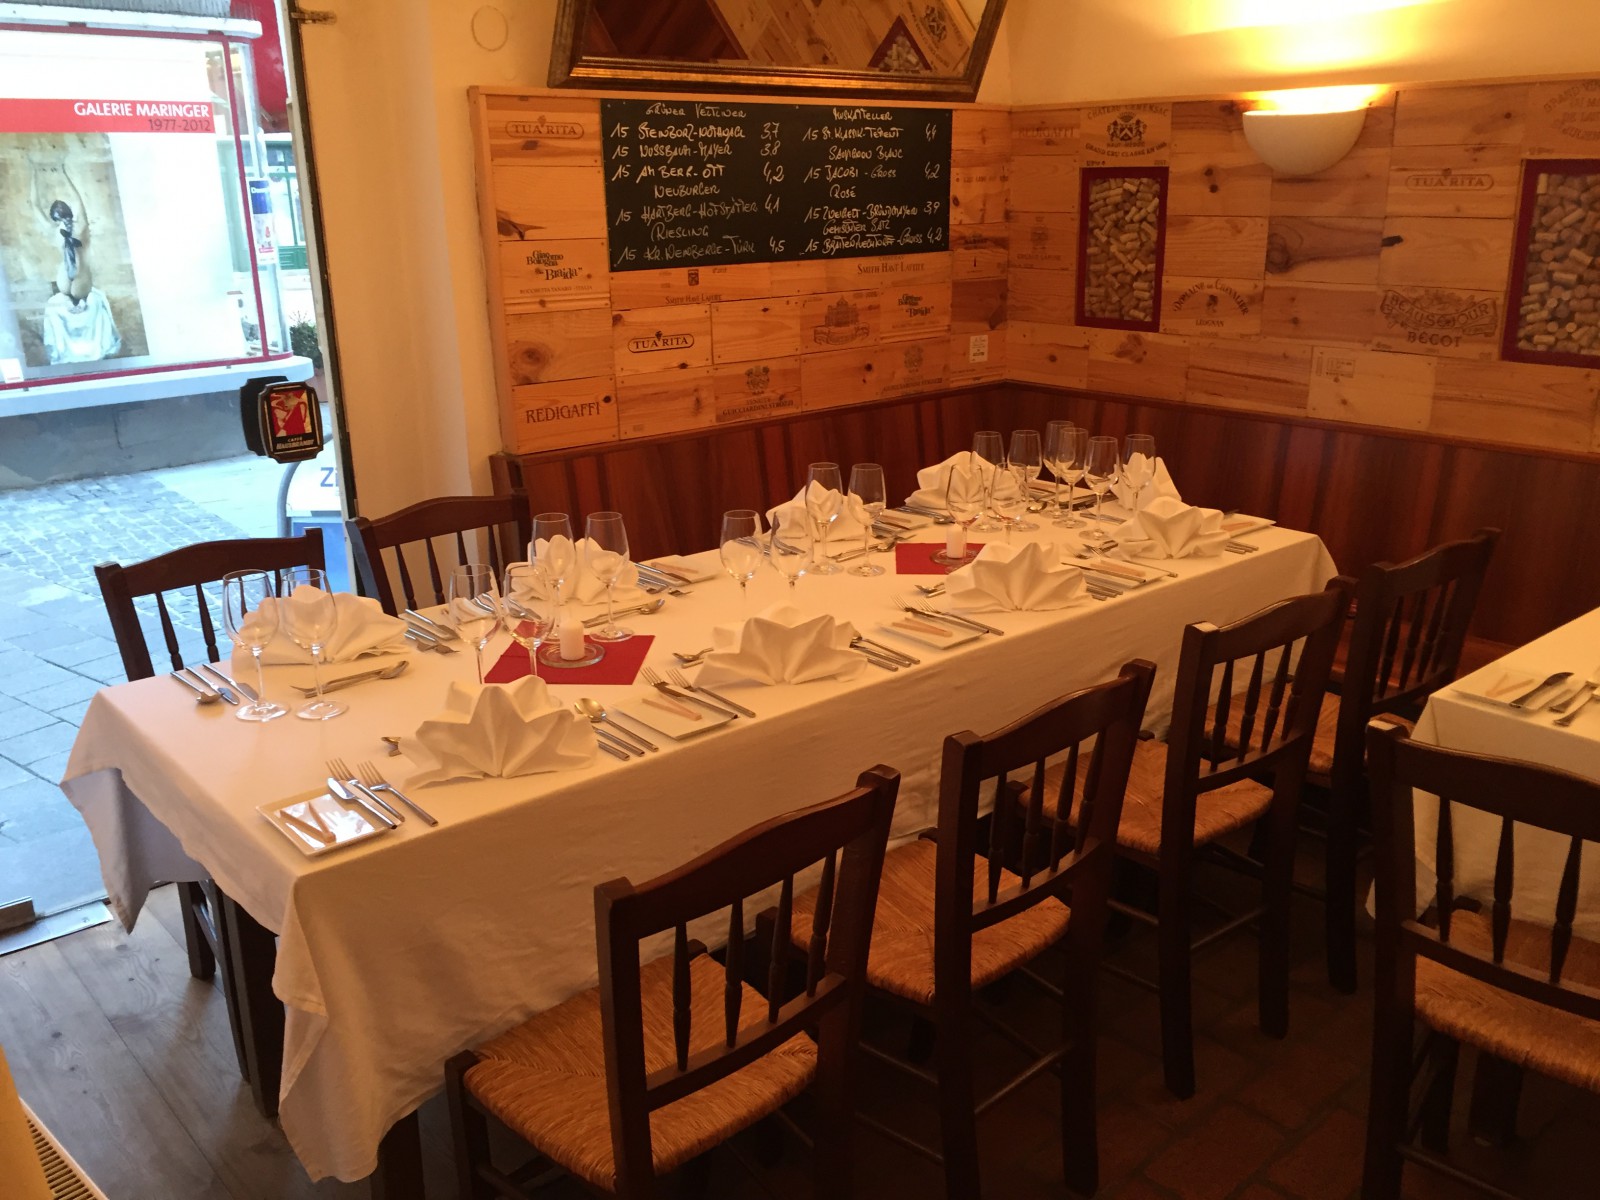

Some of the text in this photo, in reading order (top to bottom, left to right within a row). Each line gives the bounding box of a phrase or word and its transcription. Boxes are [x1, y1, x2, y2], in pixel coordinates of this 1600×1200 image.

[73, 102, 210, 117] GALERIE MARINGER
[148, 118, 211, 131] 1977-2012
[511, 124, 578, 136] TUA RITA
[610, 122, 630, 138] 15
[802, 127, 819, 142] 15
[611, 145, 630, 160] 15
[611, 165, 631, 182] 15
[803, 166, 822, 183] 15
[1413, 176, 1486, 188] TUA RITA
[616, 209, 632, 226] 15
[804, 207, 822, 223] 15
[651, 222, 709, 242] RIESLING
[805, 239, 820, 253] 15
[617, 246, 637, 264] 15
[633, 335, 689, 350] TUA RITA
[525, 402, 600, 424] REDIGAFFI
